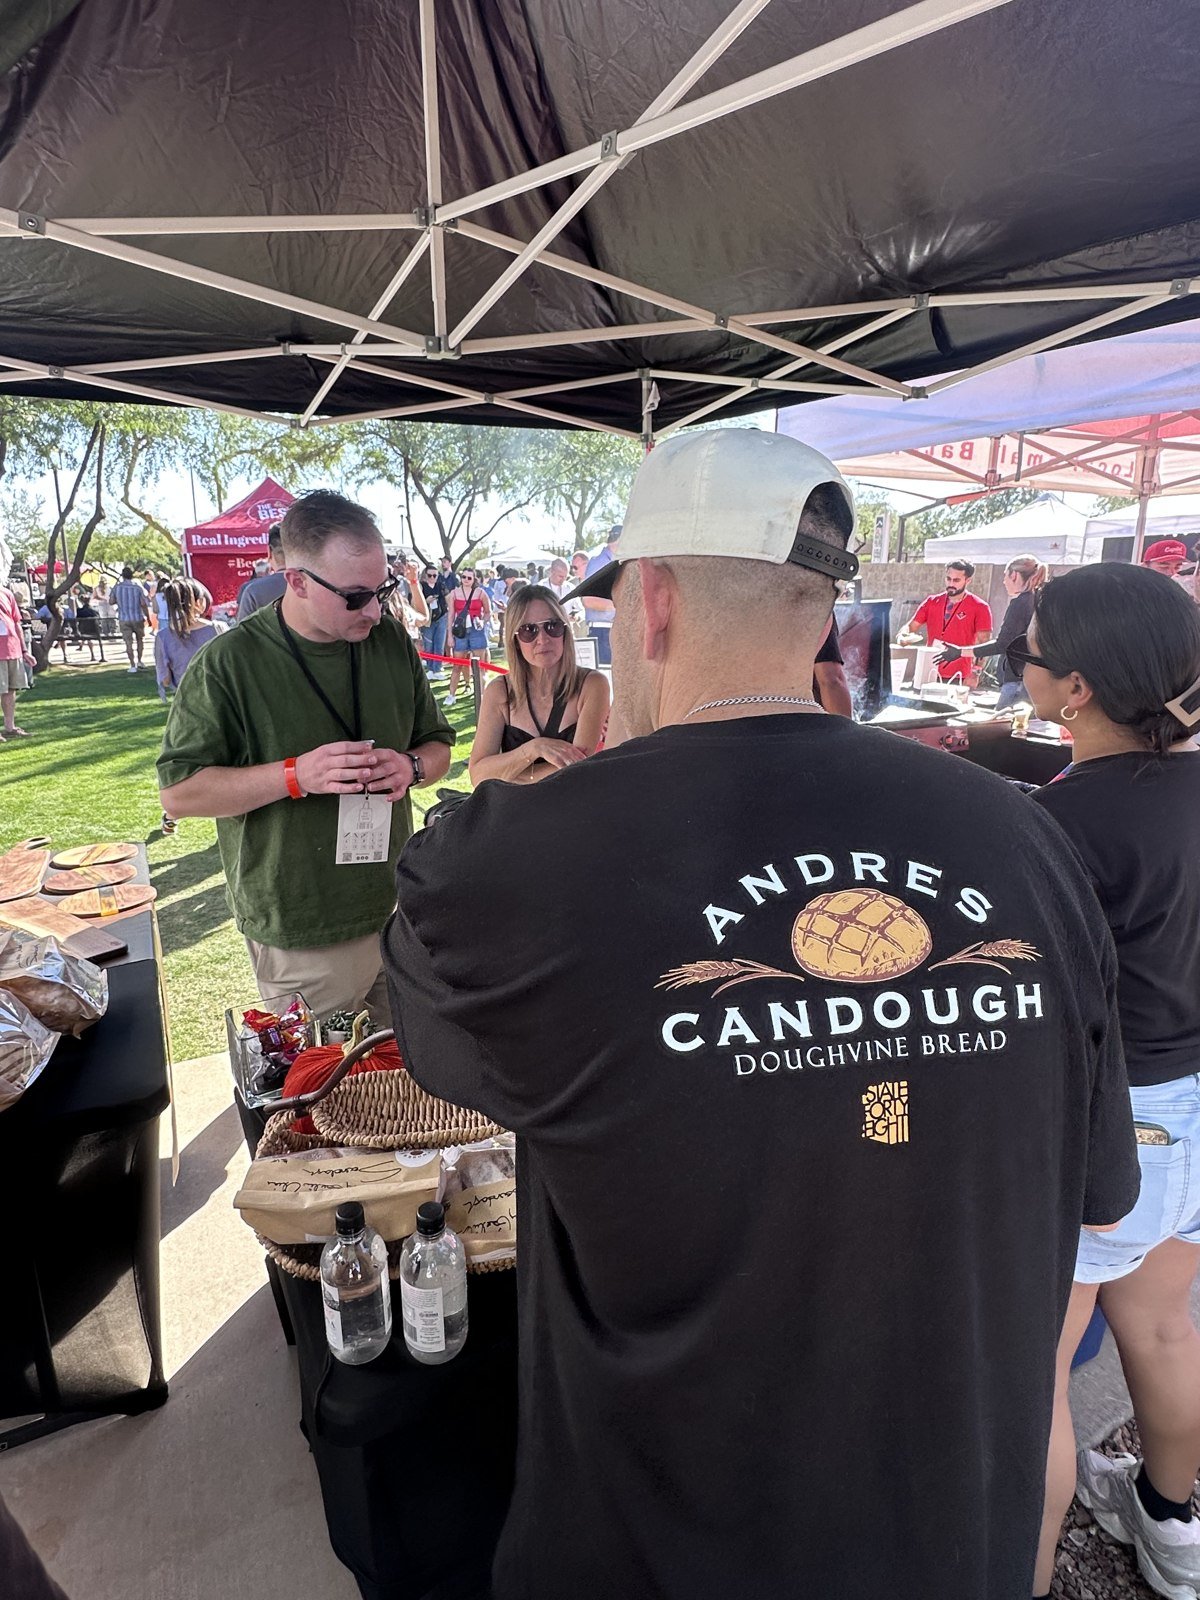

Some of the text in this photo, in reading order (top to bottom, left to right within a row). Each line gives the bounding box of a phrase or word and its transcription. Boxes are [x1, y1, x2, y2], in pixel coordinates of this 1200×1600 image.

[257, 503, 272, 511] THE
[258, 508, 287, 521] BES
[191, 533, 269, 548] Real Ingredi
[702, 851, 993, 945] ANDRES
[661, 983, 1044, 1052] CANDOUGH
[735, 1030, 1007, 1077] DOUGHVINE BREAD
[863, 1081, 909, 1103] STATE
[863, 1098, 910, 1119] FORTY
